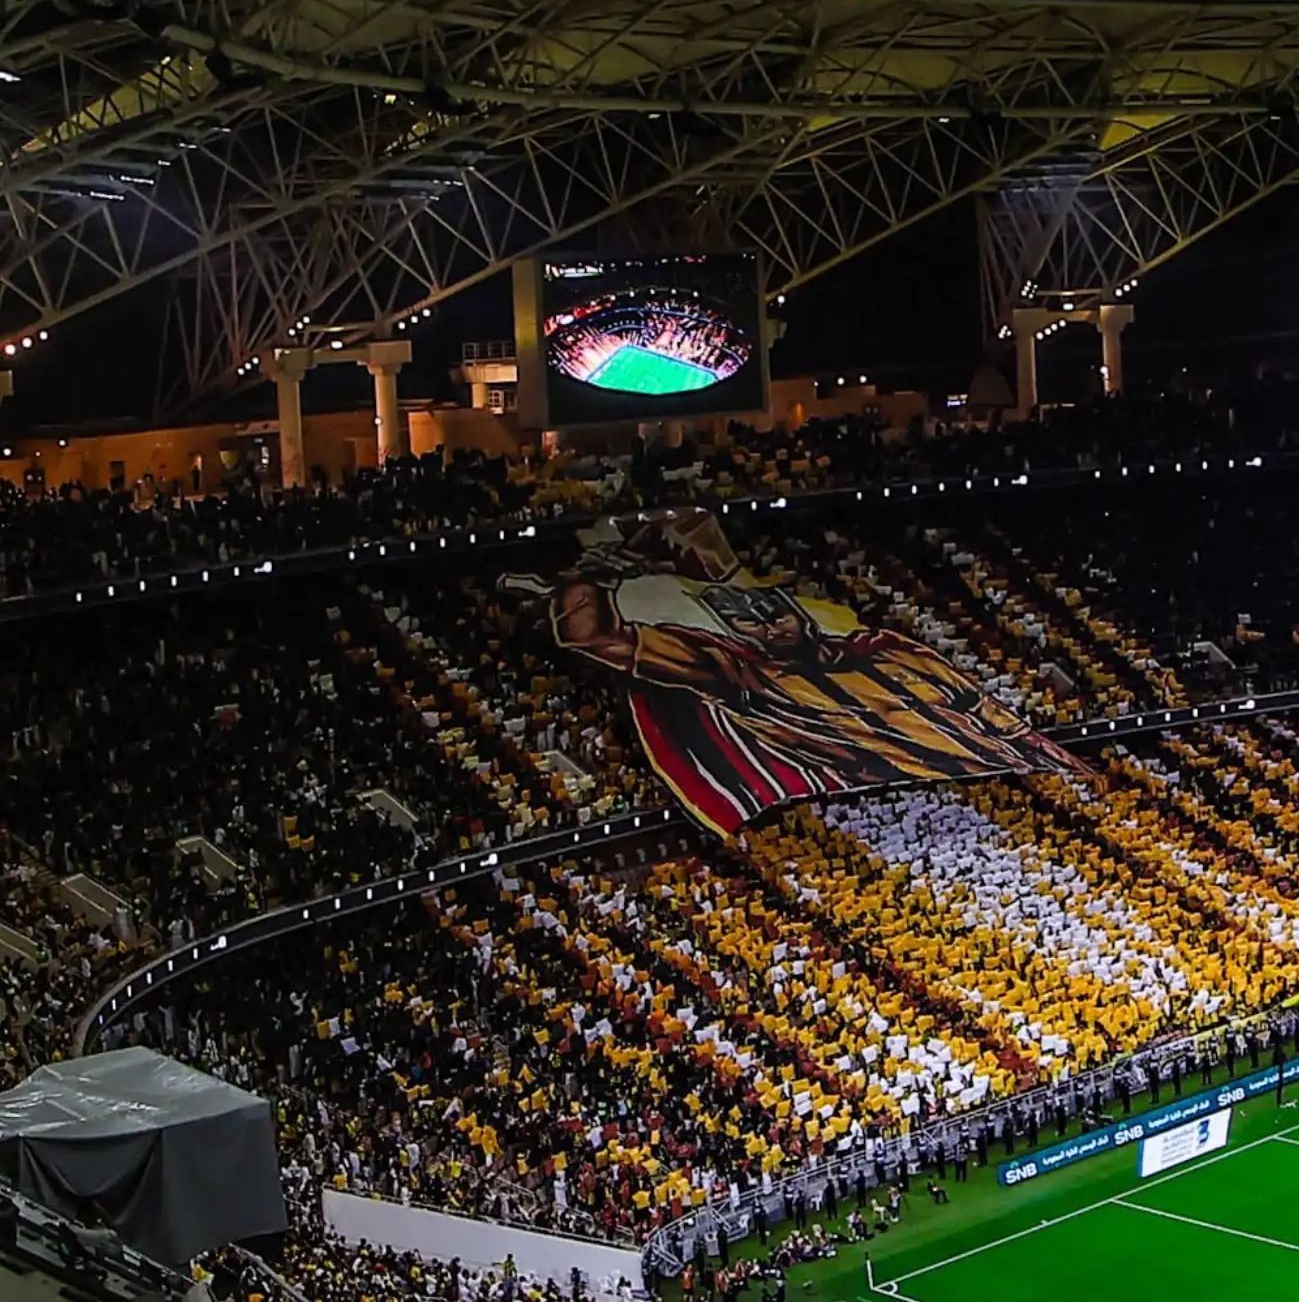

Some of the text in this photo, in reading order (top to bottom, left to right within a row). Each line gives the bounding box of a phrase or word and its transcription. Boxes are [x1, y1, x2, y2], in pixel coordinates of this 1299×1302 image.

[1218, 1089, 1246, 1106] SNB
[1115, 1127, 1144, 1144] SNB
[1006, 1165, 1037, 1183] SNB
